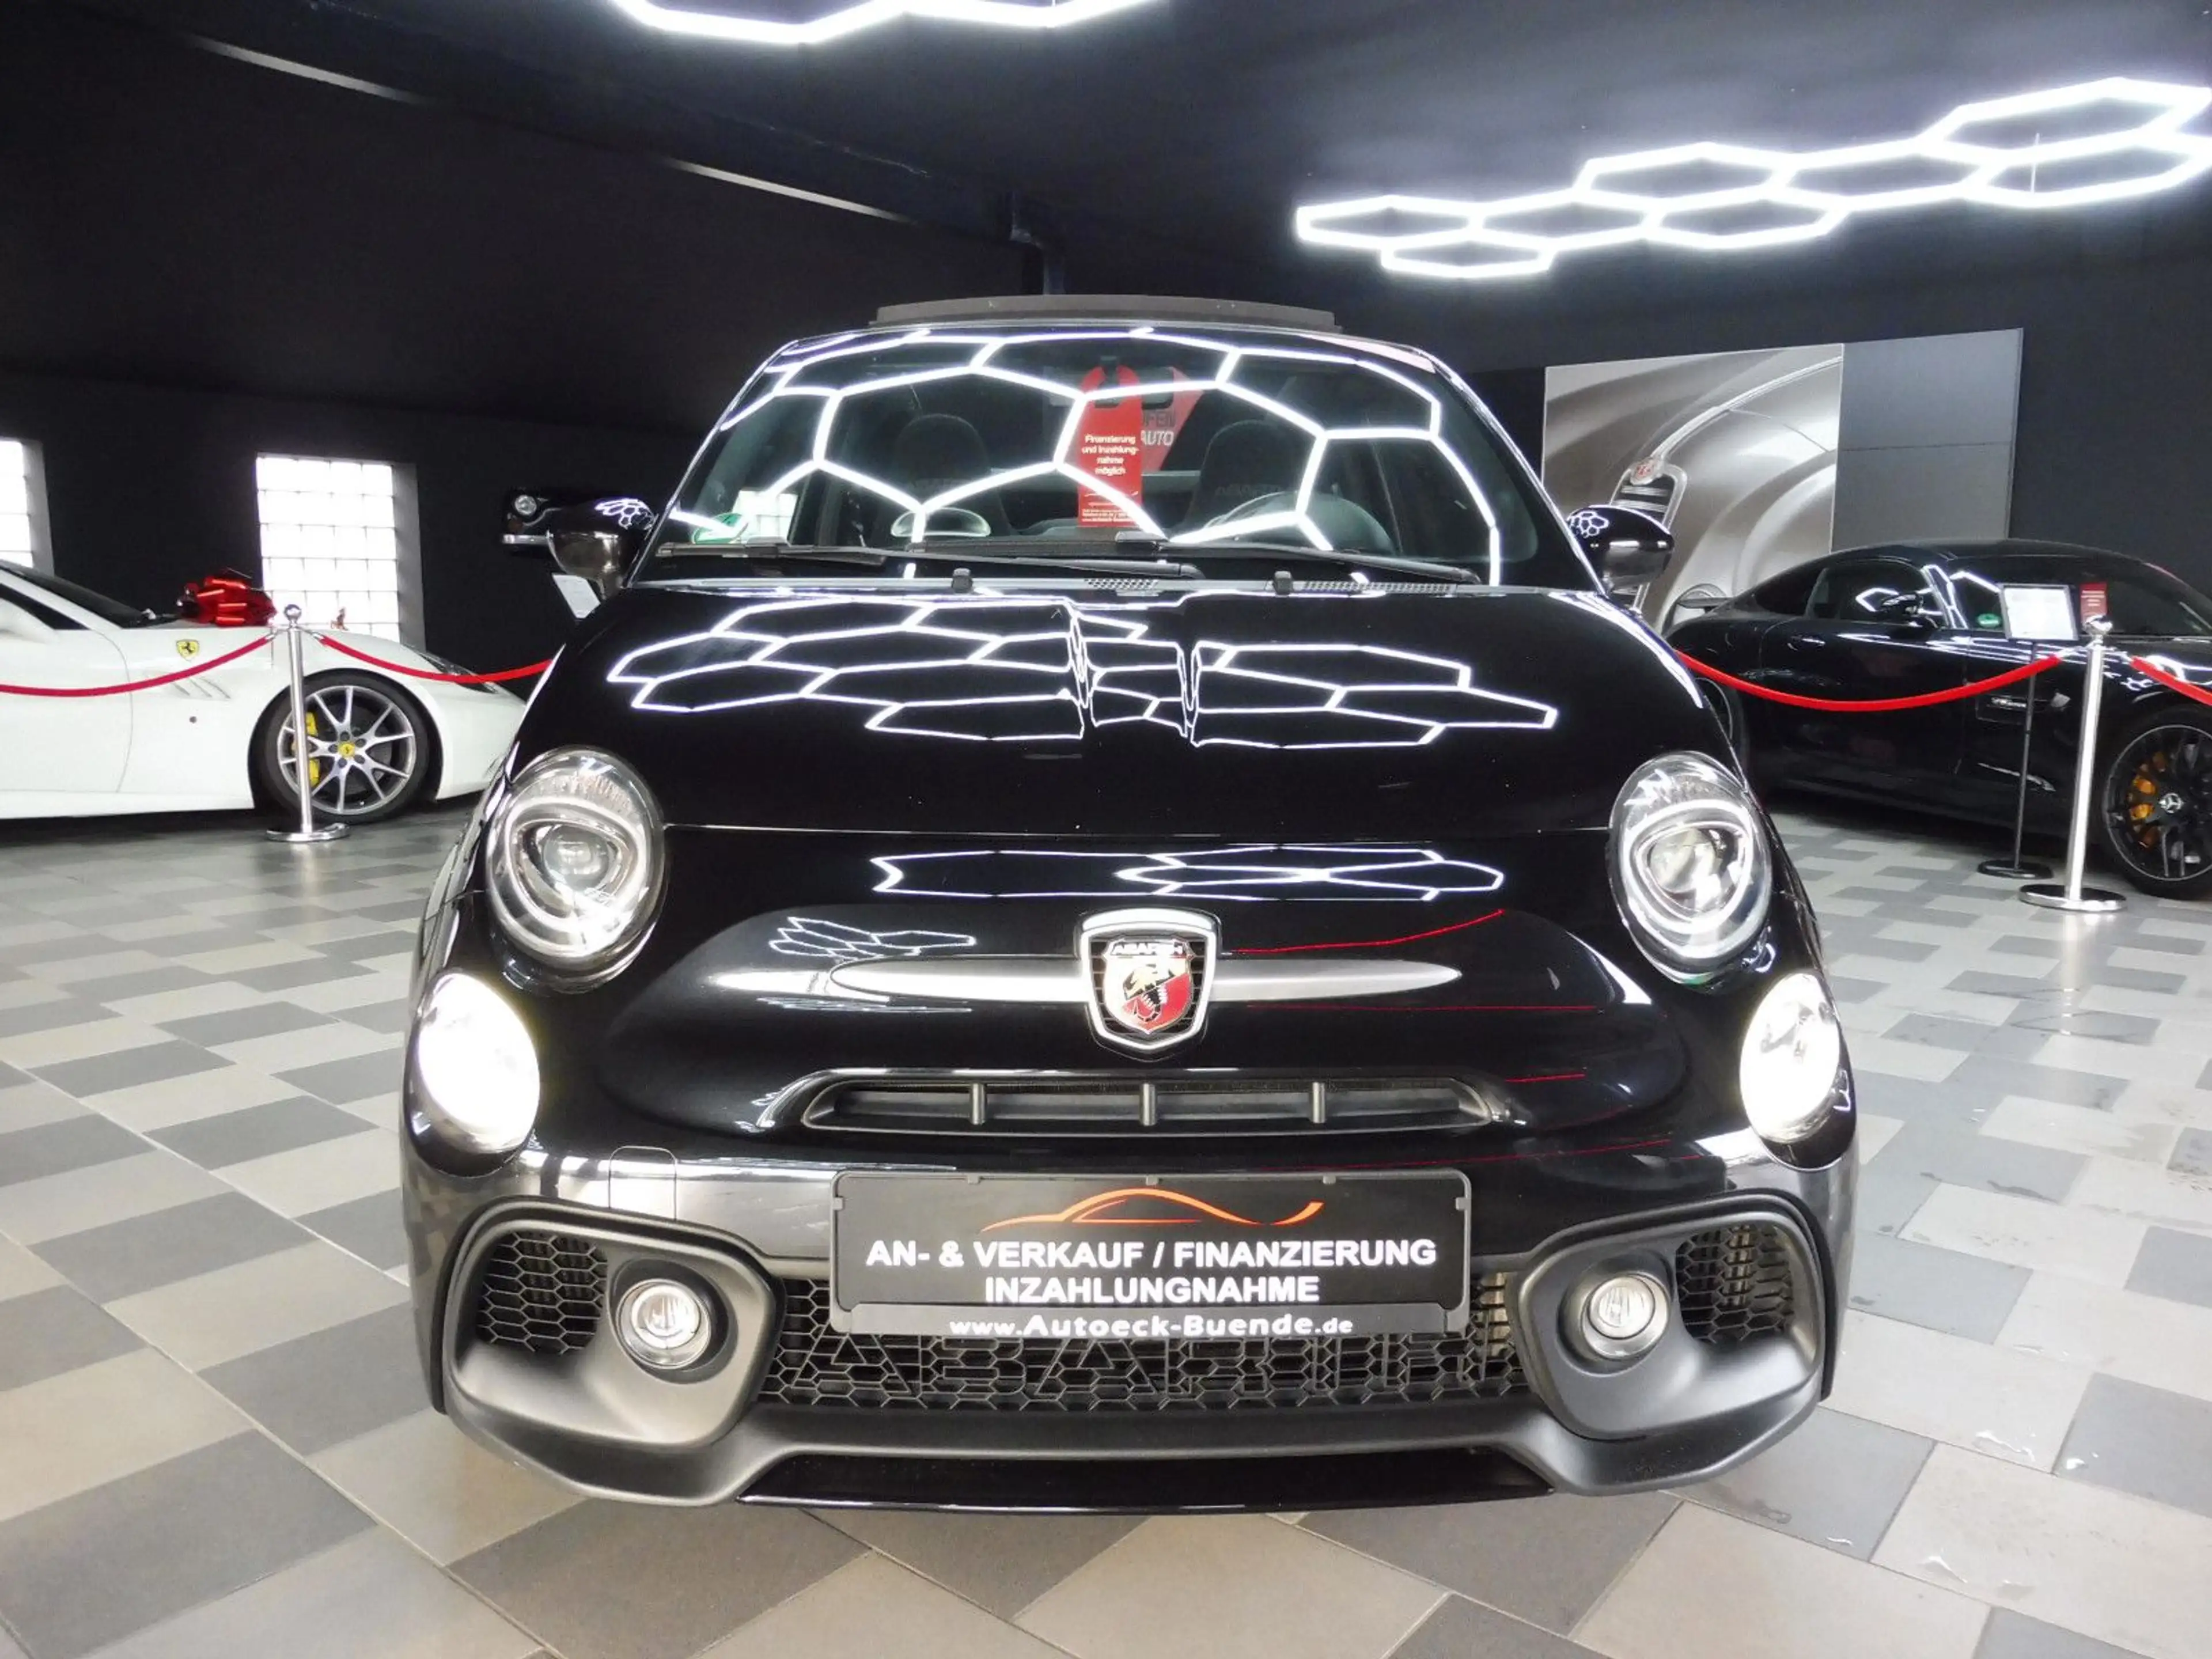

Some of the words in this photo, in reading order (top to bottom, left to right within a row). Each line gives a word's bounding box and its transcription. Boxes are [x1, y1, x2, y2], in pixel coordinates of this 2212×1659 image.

[1081, 445, 1097, 454] und
[1085, 434, 1137, 445] Finanzierung
[866, 1240, 930, 1267] AN-
[938, 1240, 964, 1268] &
[972, 1241, 1144, 1268] VERKAUF
[1153, 1241, 1165, 1268] /
[1173, 1239, 1436, 1267] FINANZIERUNG
[984, 1275, 1319, 1304] INZAHLUNGNAHME
[949, 1313, 1354, 1337] www.Autoeck-Buende.de
